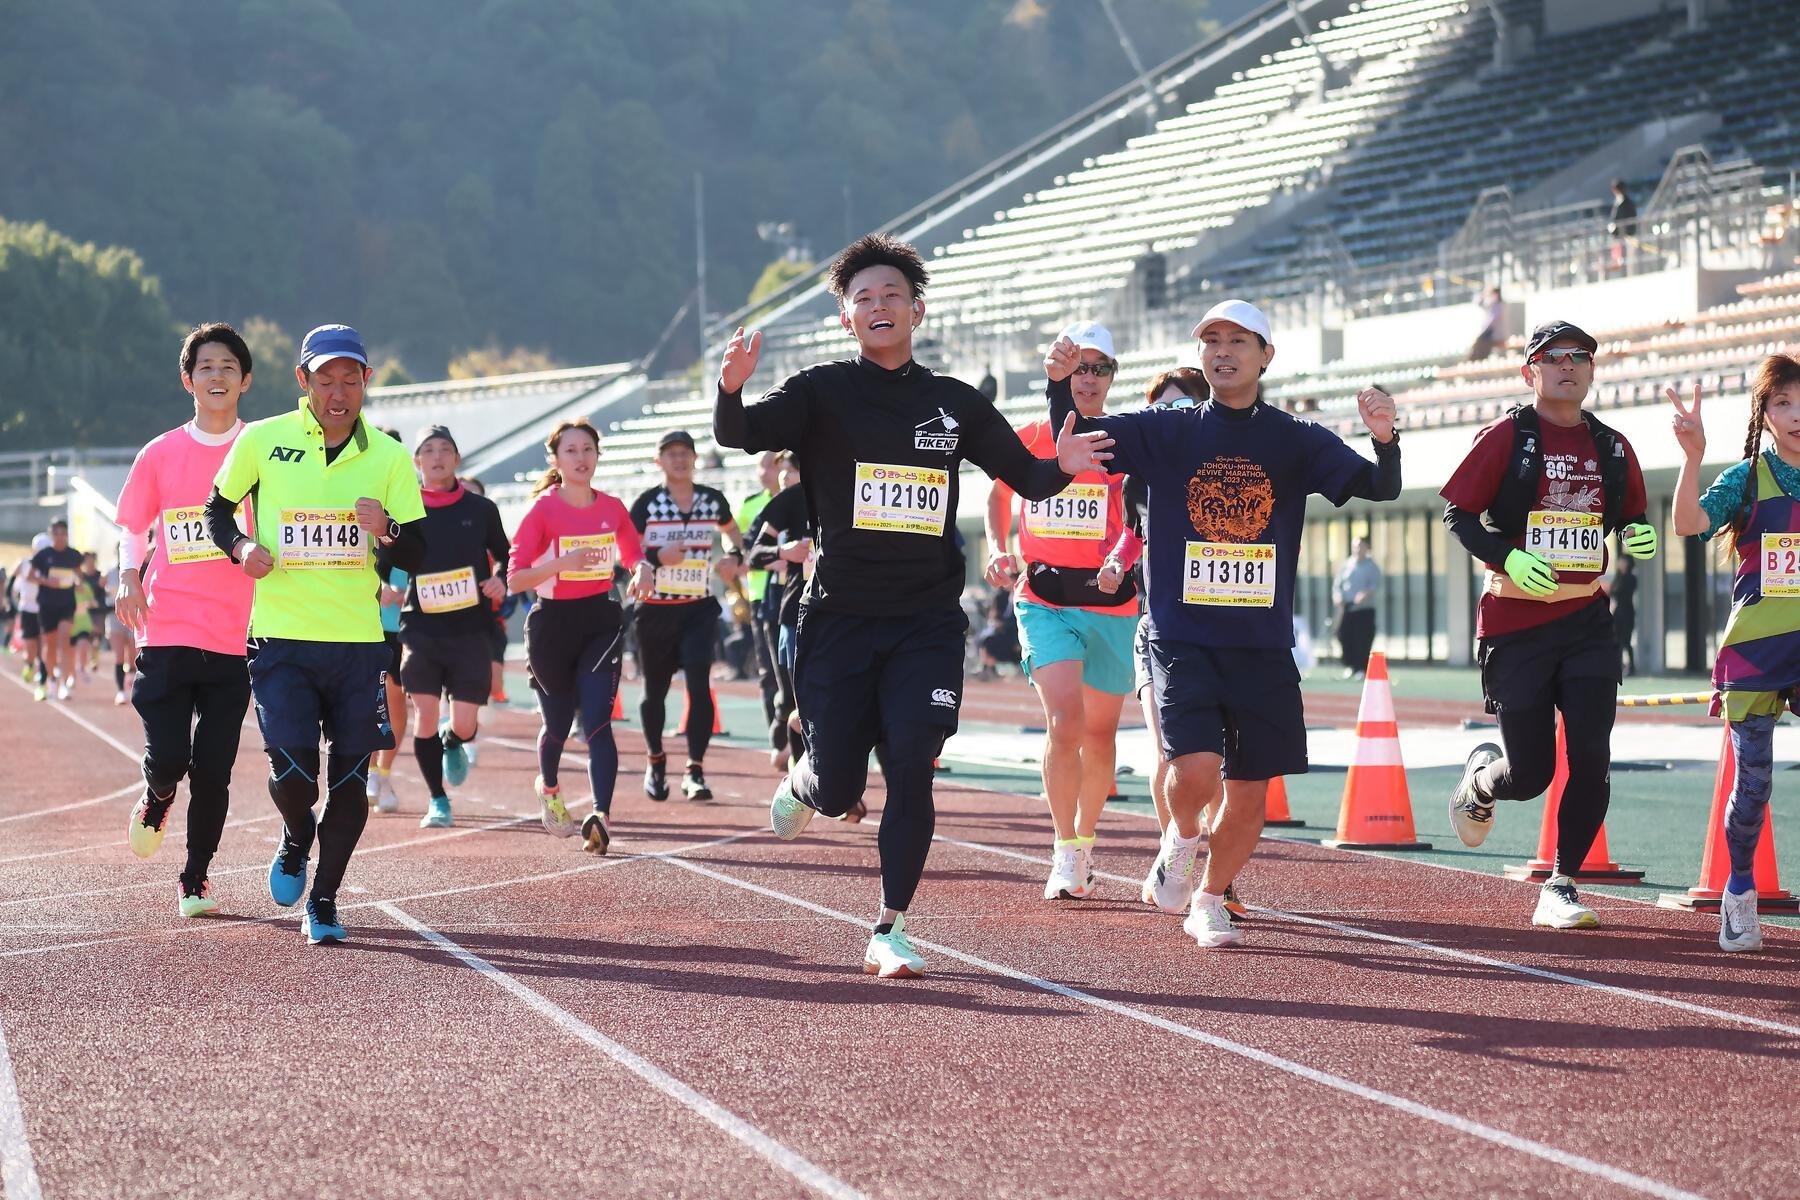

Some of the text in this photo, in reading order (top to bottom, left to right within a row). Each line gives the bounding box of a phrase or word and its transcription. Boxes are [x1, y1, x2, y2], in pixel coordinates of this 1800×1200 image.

[917, 439, 957, 448] AKENO
[1202, 462, 1261, 471] TOHOKU-MIYAGI
[1565, 454, 1578, 463] City
[1566, 474, 1602, 482] Anniversary
[861, 482, 939, 511] C 12190
[1045, 498, 1098, 519] 15196
[170, 521, 210, 542] C 12
[284, 525, 359, 547] B 14148
[1532, 528, 1598, 550] B 14160
[1190, 560, 1264, 584] B 13181
[1768, 550, 1800, 574] B 2
[660, 568, 702, 582] C 15286
[421, 580, 468, 599] C 14317
